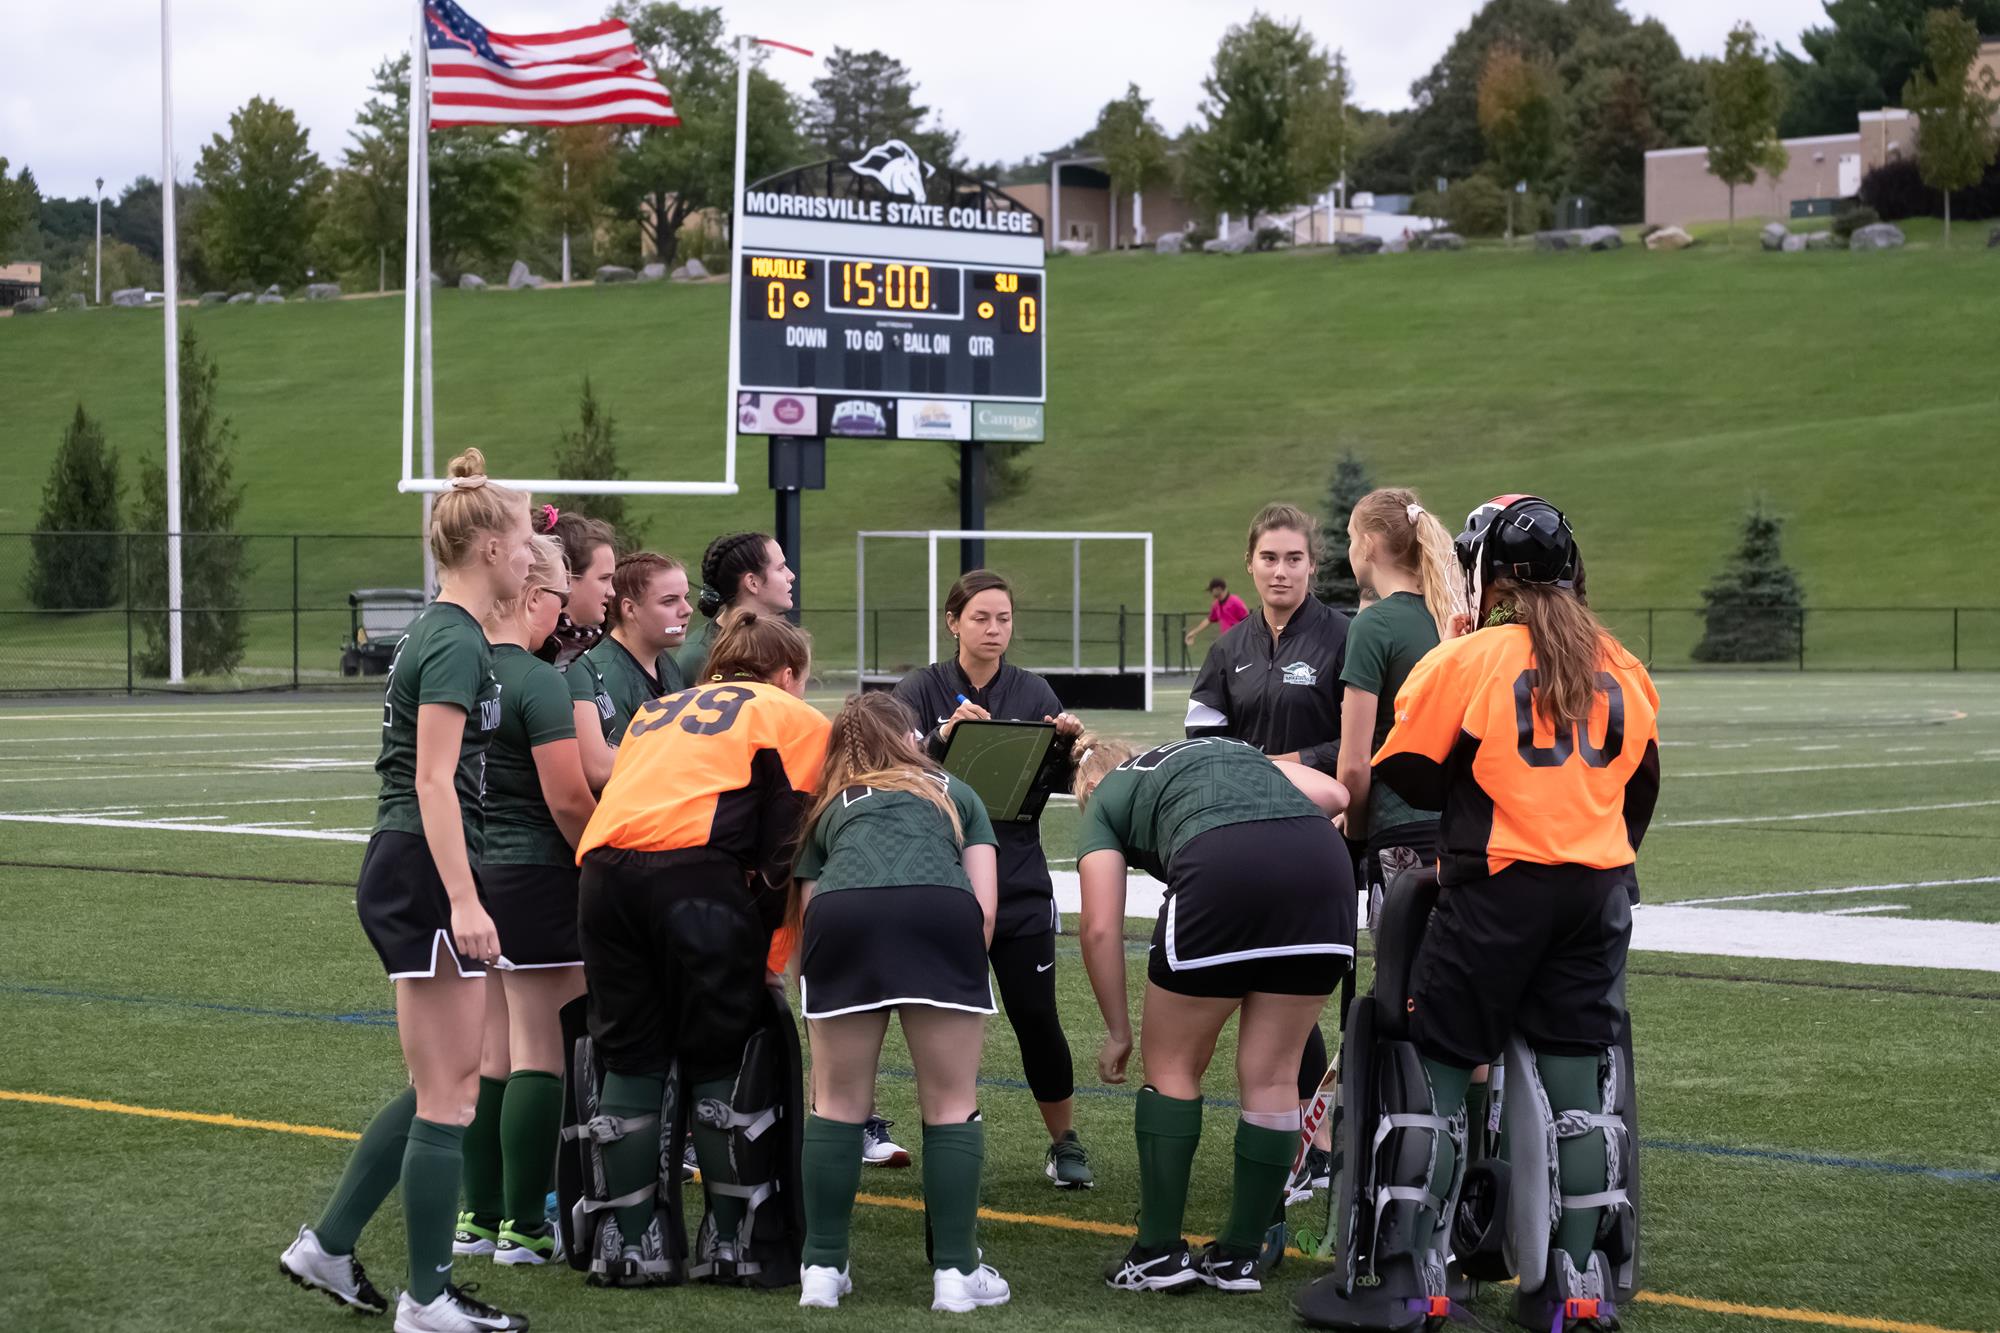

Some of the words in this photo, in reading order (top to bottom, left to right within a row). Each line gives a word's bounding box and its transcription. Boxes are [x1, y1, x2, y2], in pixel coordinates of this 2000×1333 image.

[746, 191, 882, 222] MORRISVILLE
[886, 202, 944, 227] STATE
[949, 206, 1033, 233] COLLEGE
[995, 272, 1018, 293] SLU
[767, 281, 785, 319] 0
[1019, 296, 1036, 333] 0
[786, 325, 828, 348] DOWN
[844, 329, 863, 350] TO
[865, 330, 884, 351] GO
[903, 332, 932, 354] BALL
[933, 334, 951, 355] ON
[968, 335, 995, 356] QTR
[630, 686, 756, 737] 99
[1513, 669, 1624, 768] 00
